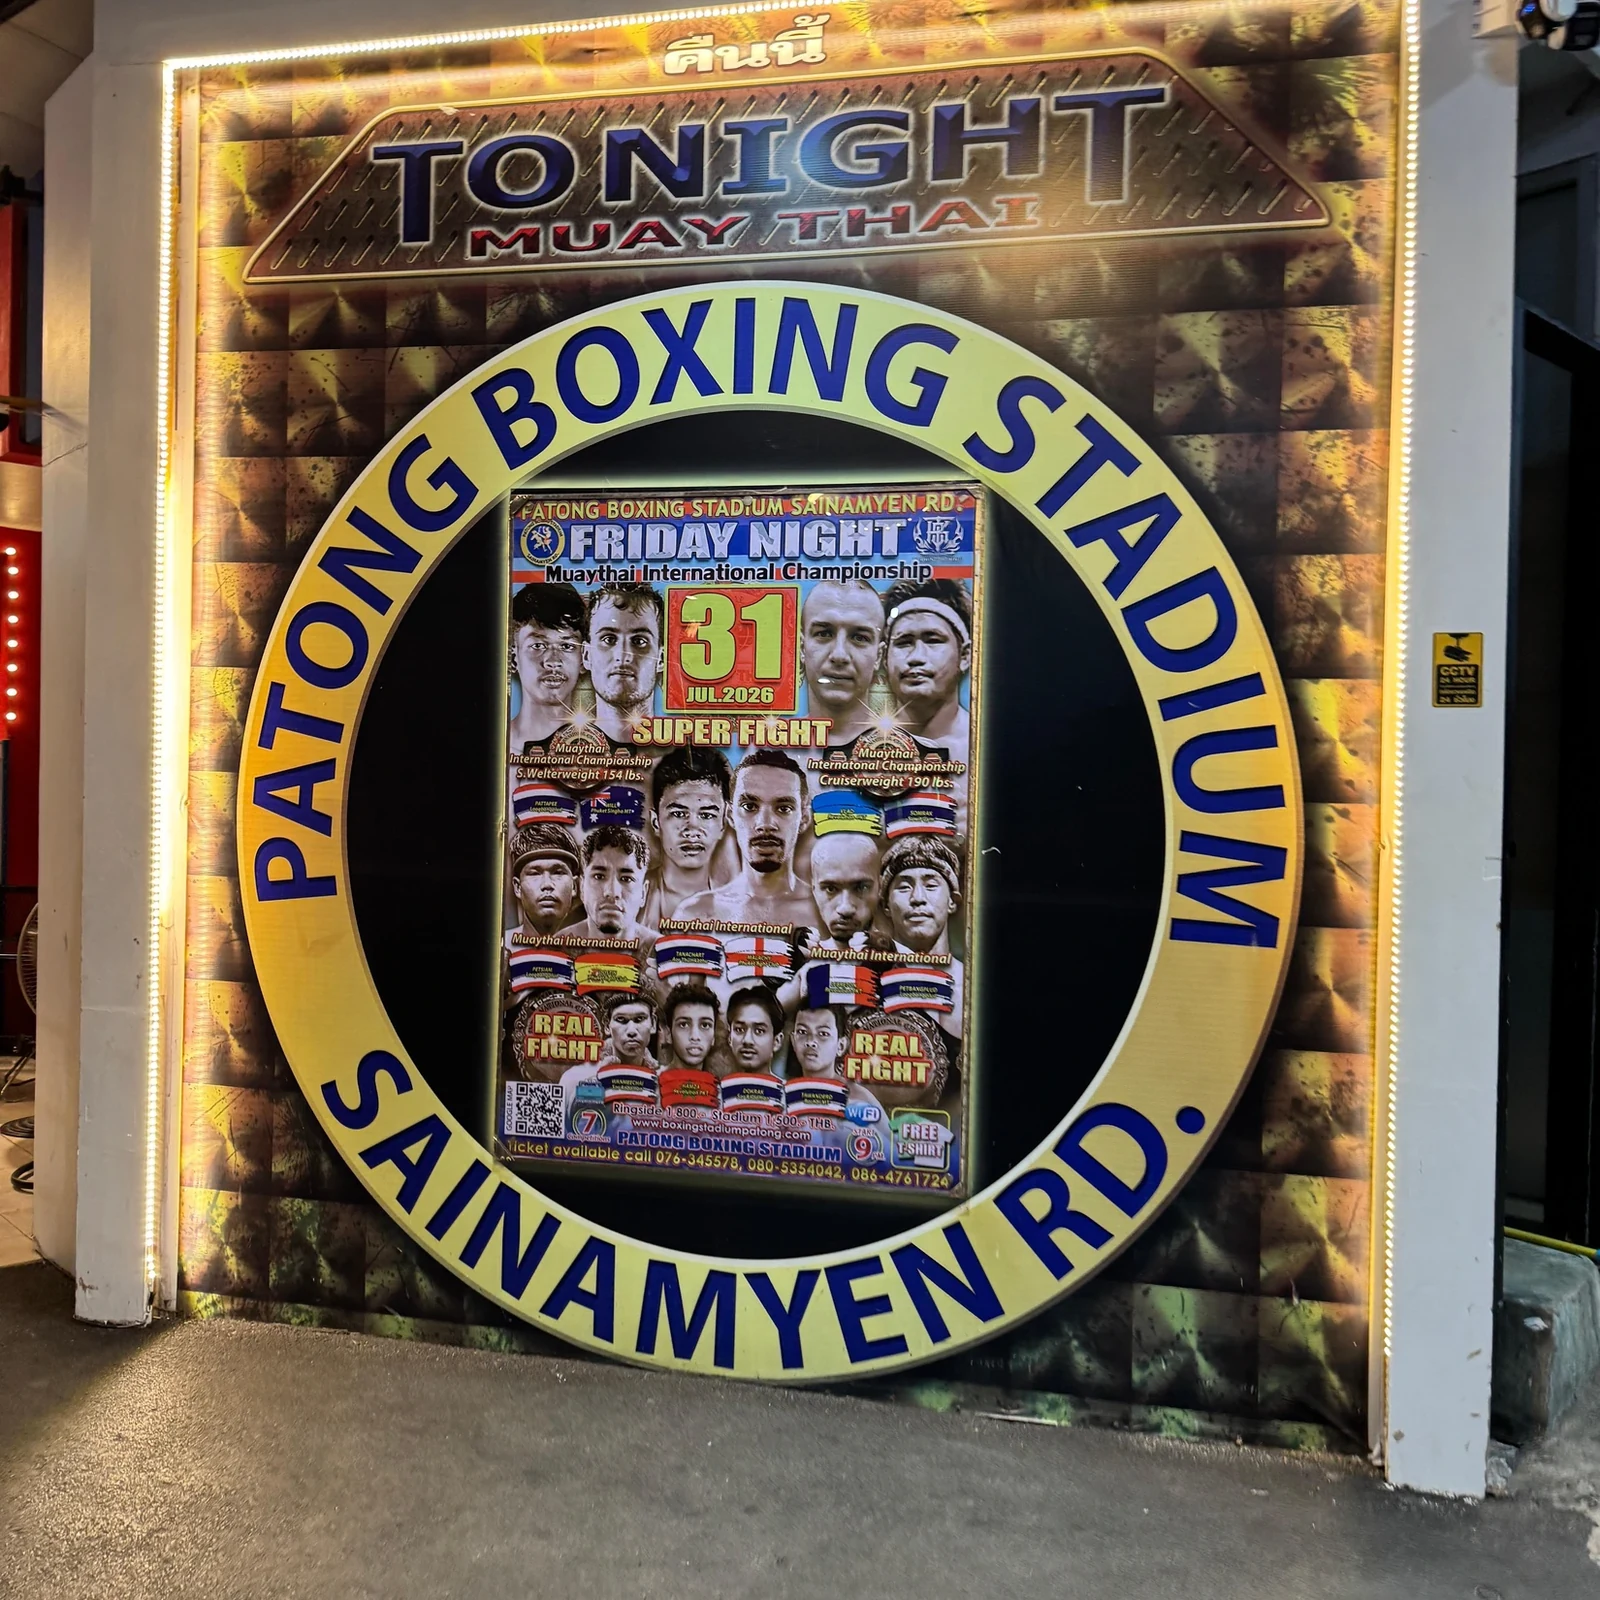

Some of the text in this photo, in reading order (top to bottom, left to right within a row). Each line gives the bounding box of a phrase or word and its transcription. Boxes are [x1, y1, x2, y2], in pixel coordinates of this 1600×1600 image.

[664, 14, 831, 74] คืนนี้
[371, 85, 1170, 248] TONIGHT
[465, 192, 1042, 258] MUAY THAI
[521, 501, 599, 520] PATONG
[607, 500, 684, 519] BOXING
[692, 498, 784, 517] STADIUM
[791, 494, 917, 516] SAINAMYEN
[570, 518, 907, 560] FRIDAY NIGHT
[546, 561, 931, 585] Muaythai International Championship
[256, 298, 1287, 948] PATONG BOXING STADIUM
[680, 592, 783, 681] 31
[1440, 667, 1476, 676] CCTV
[686, 686, 775, 704] JUL.2026
[632, 717, 731, 746] SUPER
[740, 719, 832, 747] FIGHT
[556, 743, 605, 755] Muaythai
[858, 748, 914, 760] Muaythai
[576, 755, 652, 768] Championship
[882, 761, 966, 774] Championship
[517, 768, 644, 780] S.Welterweight 154 lbs.
[820, 775, 953, 788] Cruiserweight 190 lbs.
[659, 918, 793, 934] Muaythai International
[512, 933, 639, 949] Muaythai International
[811, 948, 951, 964] Muaythai International
[535, 1014, 596, 1036] REAL
[526, 1037, 602, 1062] FIGHT
[855, 1032, 923, 1058] REAL
[847, 1059, 931, 1083] FIGHT
[581, 1111, 598, 1135] 7
[613, 1102, 662, 1116] Ringside
[712, 1109, 761, 1121] Stadium
[632, 1119, 811, 1140] www.boxingstadiumpatong.com
[902, 1123, 938, 1141] FREE
[617, 1130, 842, 1163] PATONG BOXING STADIUM
[854, 1136, 873, 1160] 9
[897, 1142, 944, 1158] T-SHIRT
[508, 1140, 949, 1189] Ticket available call 076-345578, 080-5354042, 086-4761724
[322, 1050, 1206, 1370] SAINAMYEN RD.
